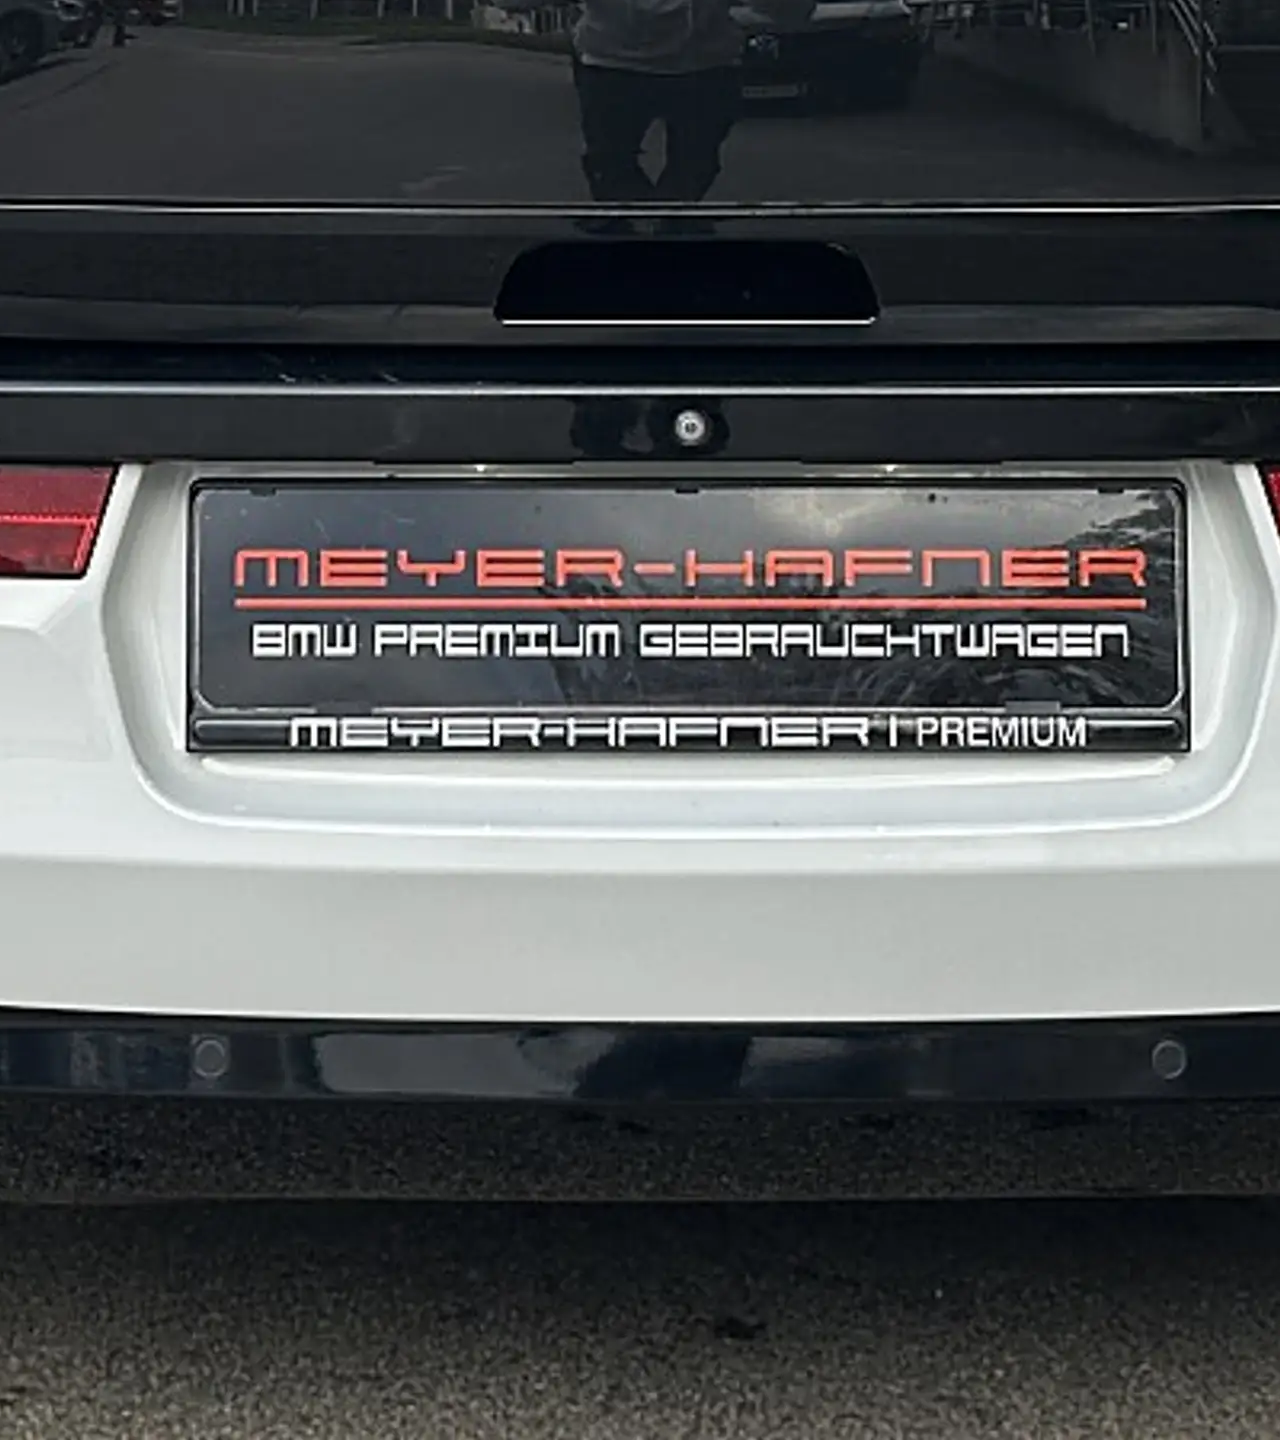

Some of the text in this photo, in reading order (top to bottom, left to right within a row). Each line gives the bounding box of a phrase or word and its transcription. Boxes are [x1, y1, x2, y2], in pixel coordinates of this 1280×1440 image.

[234, 548, 1146, 587] MEYER-HAFNER
[252, 624, 1128, 656] BMW PREMIUM GEBRAUCHTWAGEN
[289, 716, 870, 747] MEYER-HAFNER
[917, 716, 1087, 747] PREMIUM
